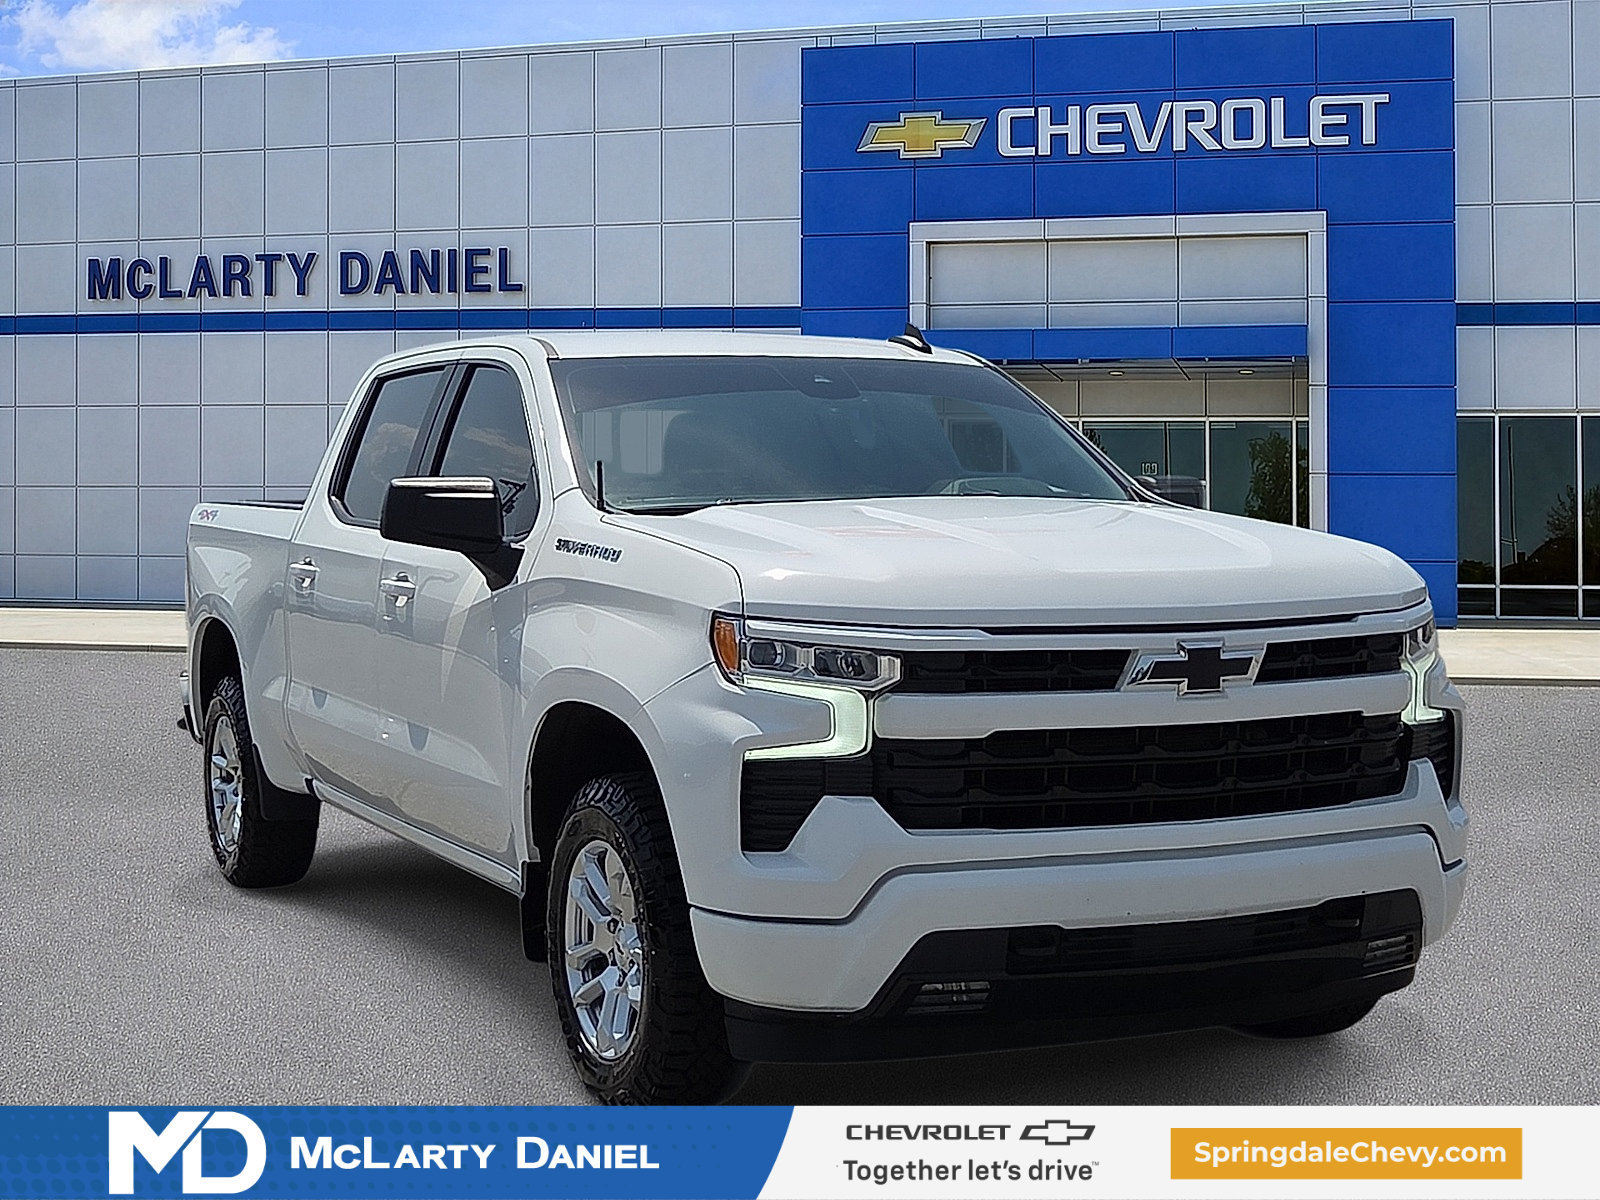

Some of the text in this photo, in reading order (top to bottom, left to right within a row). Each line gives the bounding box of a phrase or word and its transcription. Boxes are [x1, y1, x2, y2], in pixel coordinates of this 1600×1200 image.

[996, 93, 1391, 158] CHEVROLET
[86, 246, 525, 300] MCLARTY DANIEL
